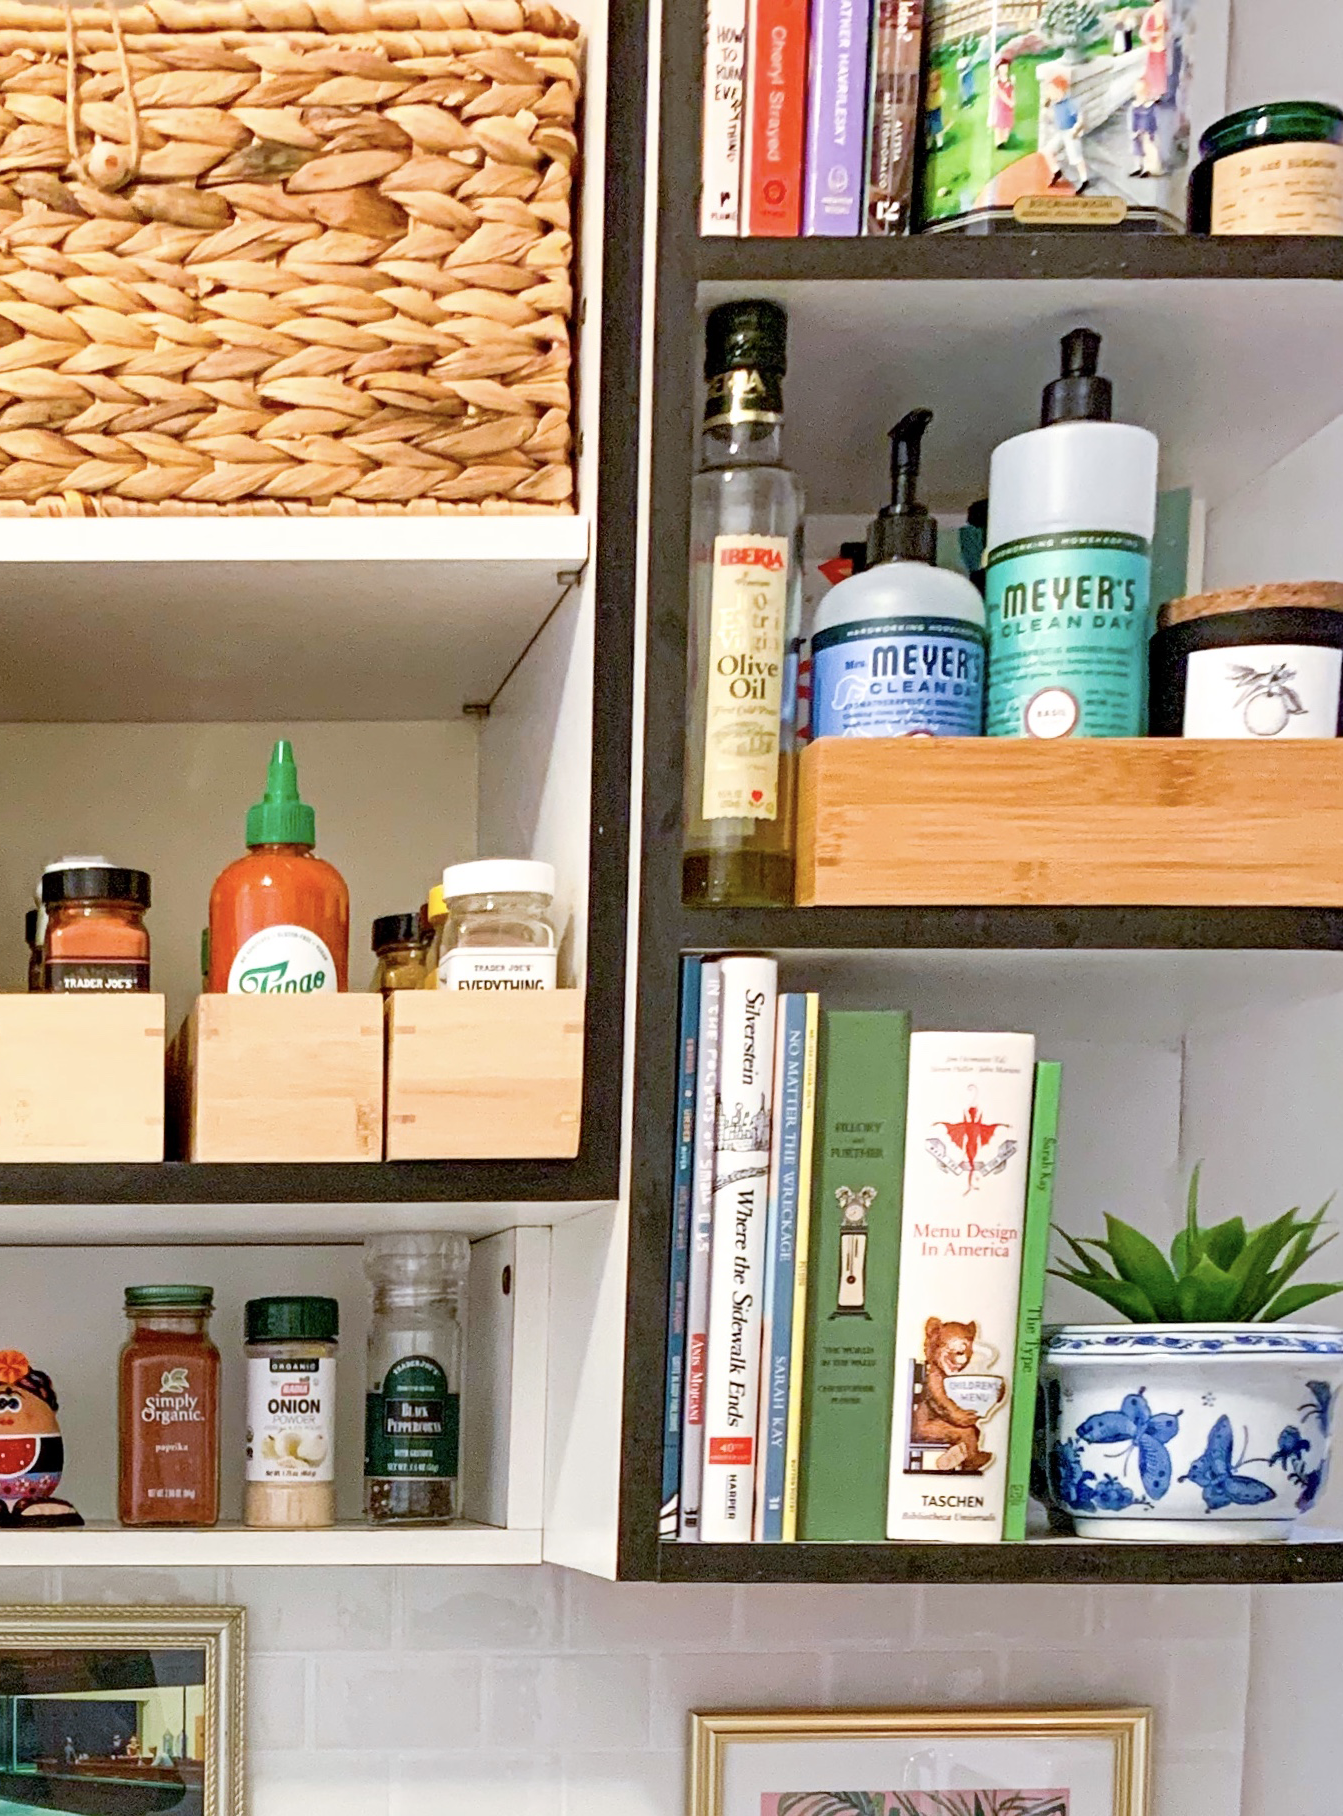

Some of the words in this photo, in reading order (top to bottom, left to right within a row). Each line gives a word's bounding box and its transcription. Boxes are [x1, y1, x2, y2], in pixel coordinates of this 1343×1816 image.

[722, 48, 739, 62] TO
[767, 26, 788, 85] Cheryl
[766, 91, 785, 162] Strayed
[720, 548, 784, 571] IBERIA
[1003, 575, 1137, 620] MEYER'S
[1001, 615, 1082, 639] CLEAN
[1093, 615, 1134, 631] DAY
[717, 654, 779, 677] Olive
[729, 678, 766, 700] Oil
[870, 682, 947, 695] CLEAN
[64, 978, 103, 989] TRADER
[105, 978, 133, 989] JOE'S
[458, 980, 545, 990] EVERYTHING
[742, 989, 764, 1086] Silverstein
[790, 1030, 801, 1057] NO
[784, 1063, 799, 1129] MATTER
[782, 1132, 796, 1165] THE
[735, 1189, 754, 1250] Where
[778, 1172, 796, 1262] WRECKAGE
[913, 1223, 960, 1239] Menu
[967, 1223, 1018, 1244] Design
[922, 1242, 938, 1256] In
[944, 1242, 1010, 1257] America
[734, 1259, 750, 1285] the
[729, 1290, 752, 1374] Sidewalk
[1025, 1306, 1042, 1335] The
[1021, 1337, 1040, 1373] Type
[772, 1356, 787, 1410] SARAH
[145, 1393, 198, 1411] Simply
[268, 1399, 320, 1414] ONION
[728, 1381, 746, 1427] Ends
[273, 1415, 315, 1424] POWDER
[771, 1417, 785, 1448] KAY
[156, 1443, 188, 1453] paprika
[725, 1474, 737, 1520] HARPER
[922, 1495, 984, 1508] TASCHEN
